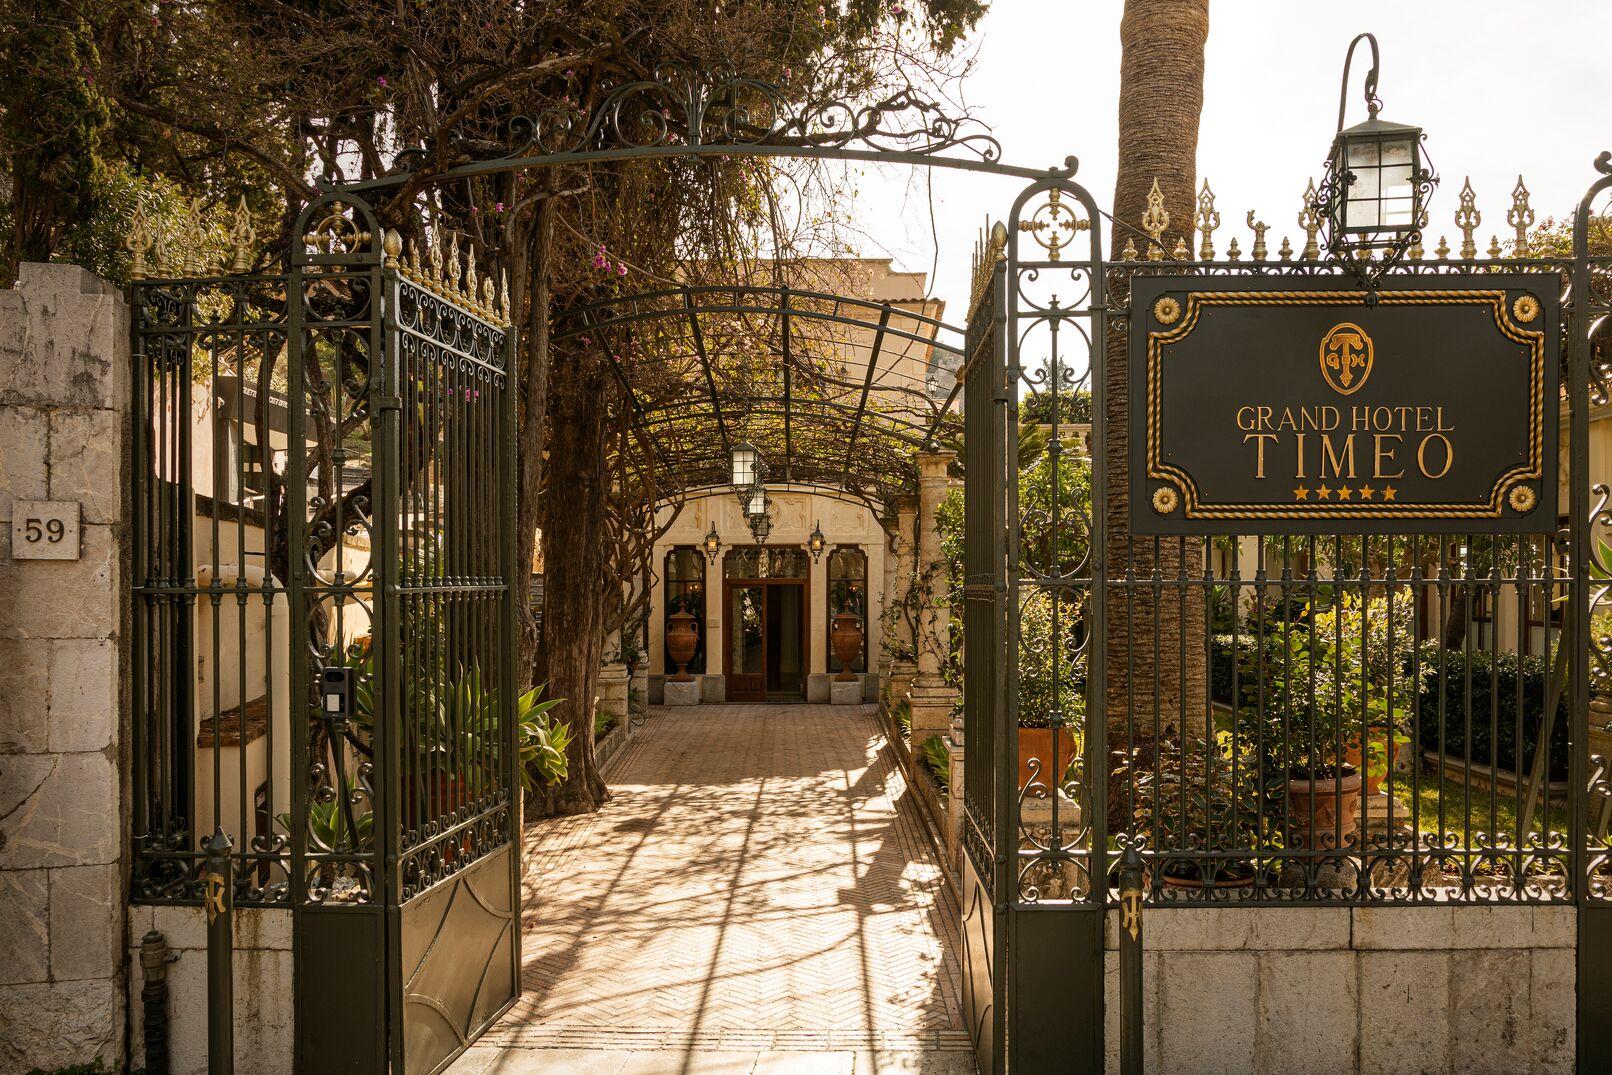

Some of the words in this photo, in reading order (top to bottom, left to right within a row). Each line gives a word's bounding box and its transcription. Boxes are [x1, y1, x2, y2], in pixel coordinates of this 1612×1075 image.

[1236, 405, 1341, 432] GRAND
[1351, 405, 1455, 432] HOTEL
[1242, 433, 1454, 479] TIMEO
[25, 518, 65, 543] 59
